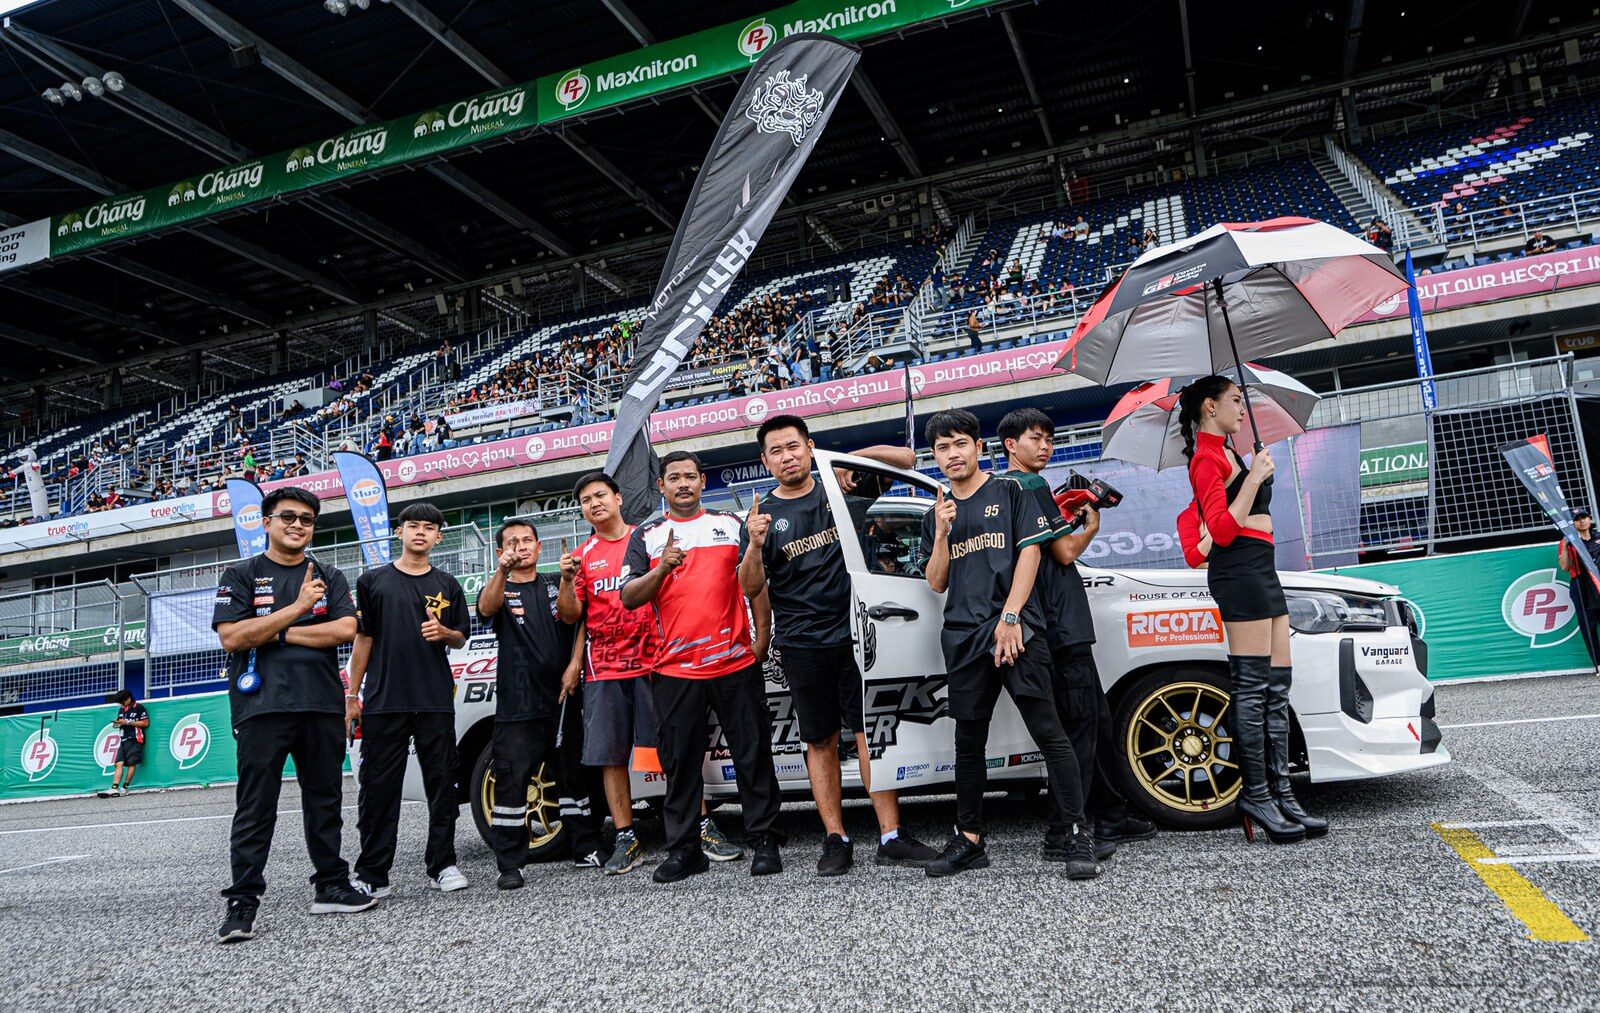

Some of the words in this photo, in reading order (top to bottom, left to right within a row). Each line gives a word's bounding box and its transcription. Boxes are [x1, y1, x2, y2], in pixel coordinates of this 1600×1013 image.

[783, 0, 896, 37] Maxnitron
[748, 28, 768, 51] PT
[597, 53, 697, 92] Maxnitron
[564, 80, 582, 100] PT
[448, 91, 525, 127] Chang
[471, 119, 504, 135] MINERAL
[317, 130, 387, 163] Chang
[337, 158, 367, 171] MINERAL
[198, 163, 264, 197] Chang
[85, 199, 146, 229] Chang
[1455, 273, 1495, 293] OUR
[1565, 336, 1595, 347] true
[935, 367, 965, 383] PUT
[969, 361, 1001, 377] OUR
[776, 390, 820, 410] จากใจ
[848, 380, 888, 402] สู่จาน
[666, 415, 697, 432] INTO
[701, 408, 737, 424] FOOD
[749, 405, 764, 417] CP
[529, 443, 542, 454] CP
[553, 435, 578, 451] PUT
[581, 432, 607, 447] OUR
[401, 466, 413, 476] CP
[151, 505, 171, 518] true
[171, 502, 195, 514] online
[984, 504, 999, 517] 95
[47, 525, 66, 536] true
[67, 520, 88, 532] online
[1523, 588, 1568, 630] PT
[1132, 610, 1219, 635] RICOTA
[35, 636, 70, 650] Chang
[472, 640, 492, 649] Solar
[1155, 634, 1167, 642] For
[1170, 632, 1220, 642] Professionals
[1362, 645, 1409, 659] Vanguard
[179, 727, 201, 757] PT
[30, 741, 49, 769] PT
